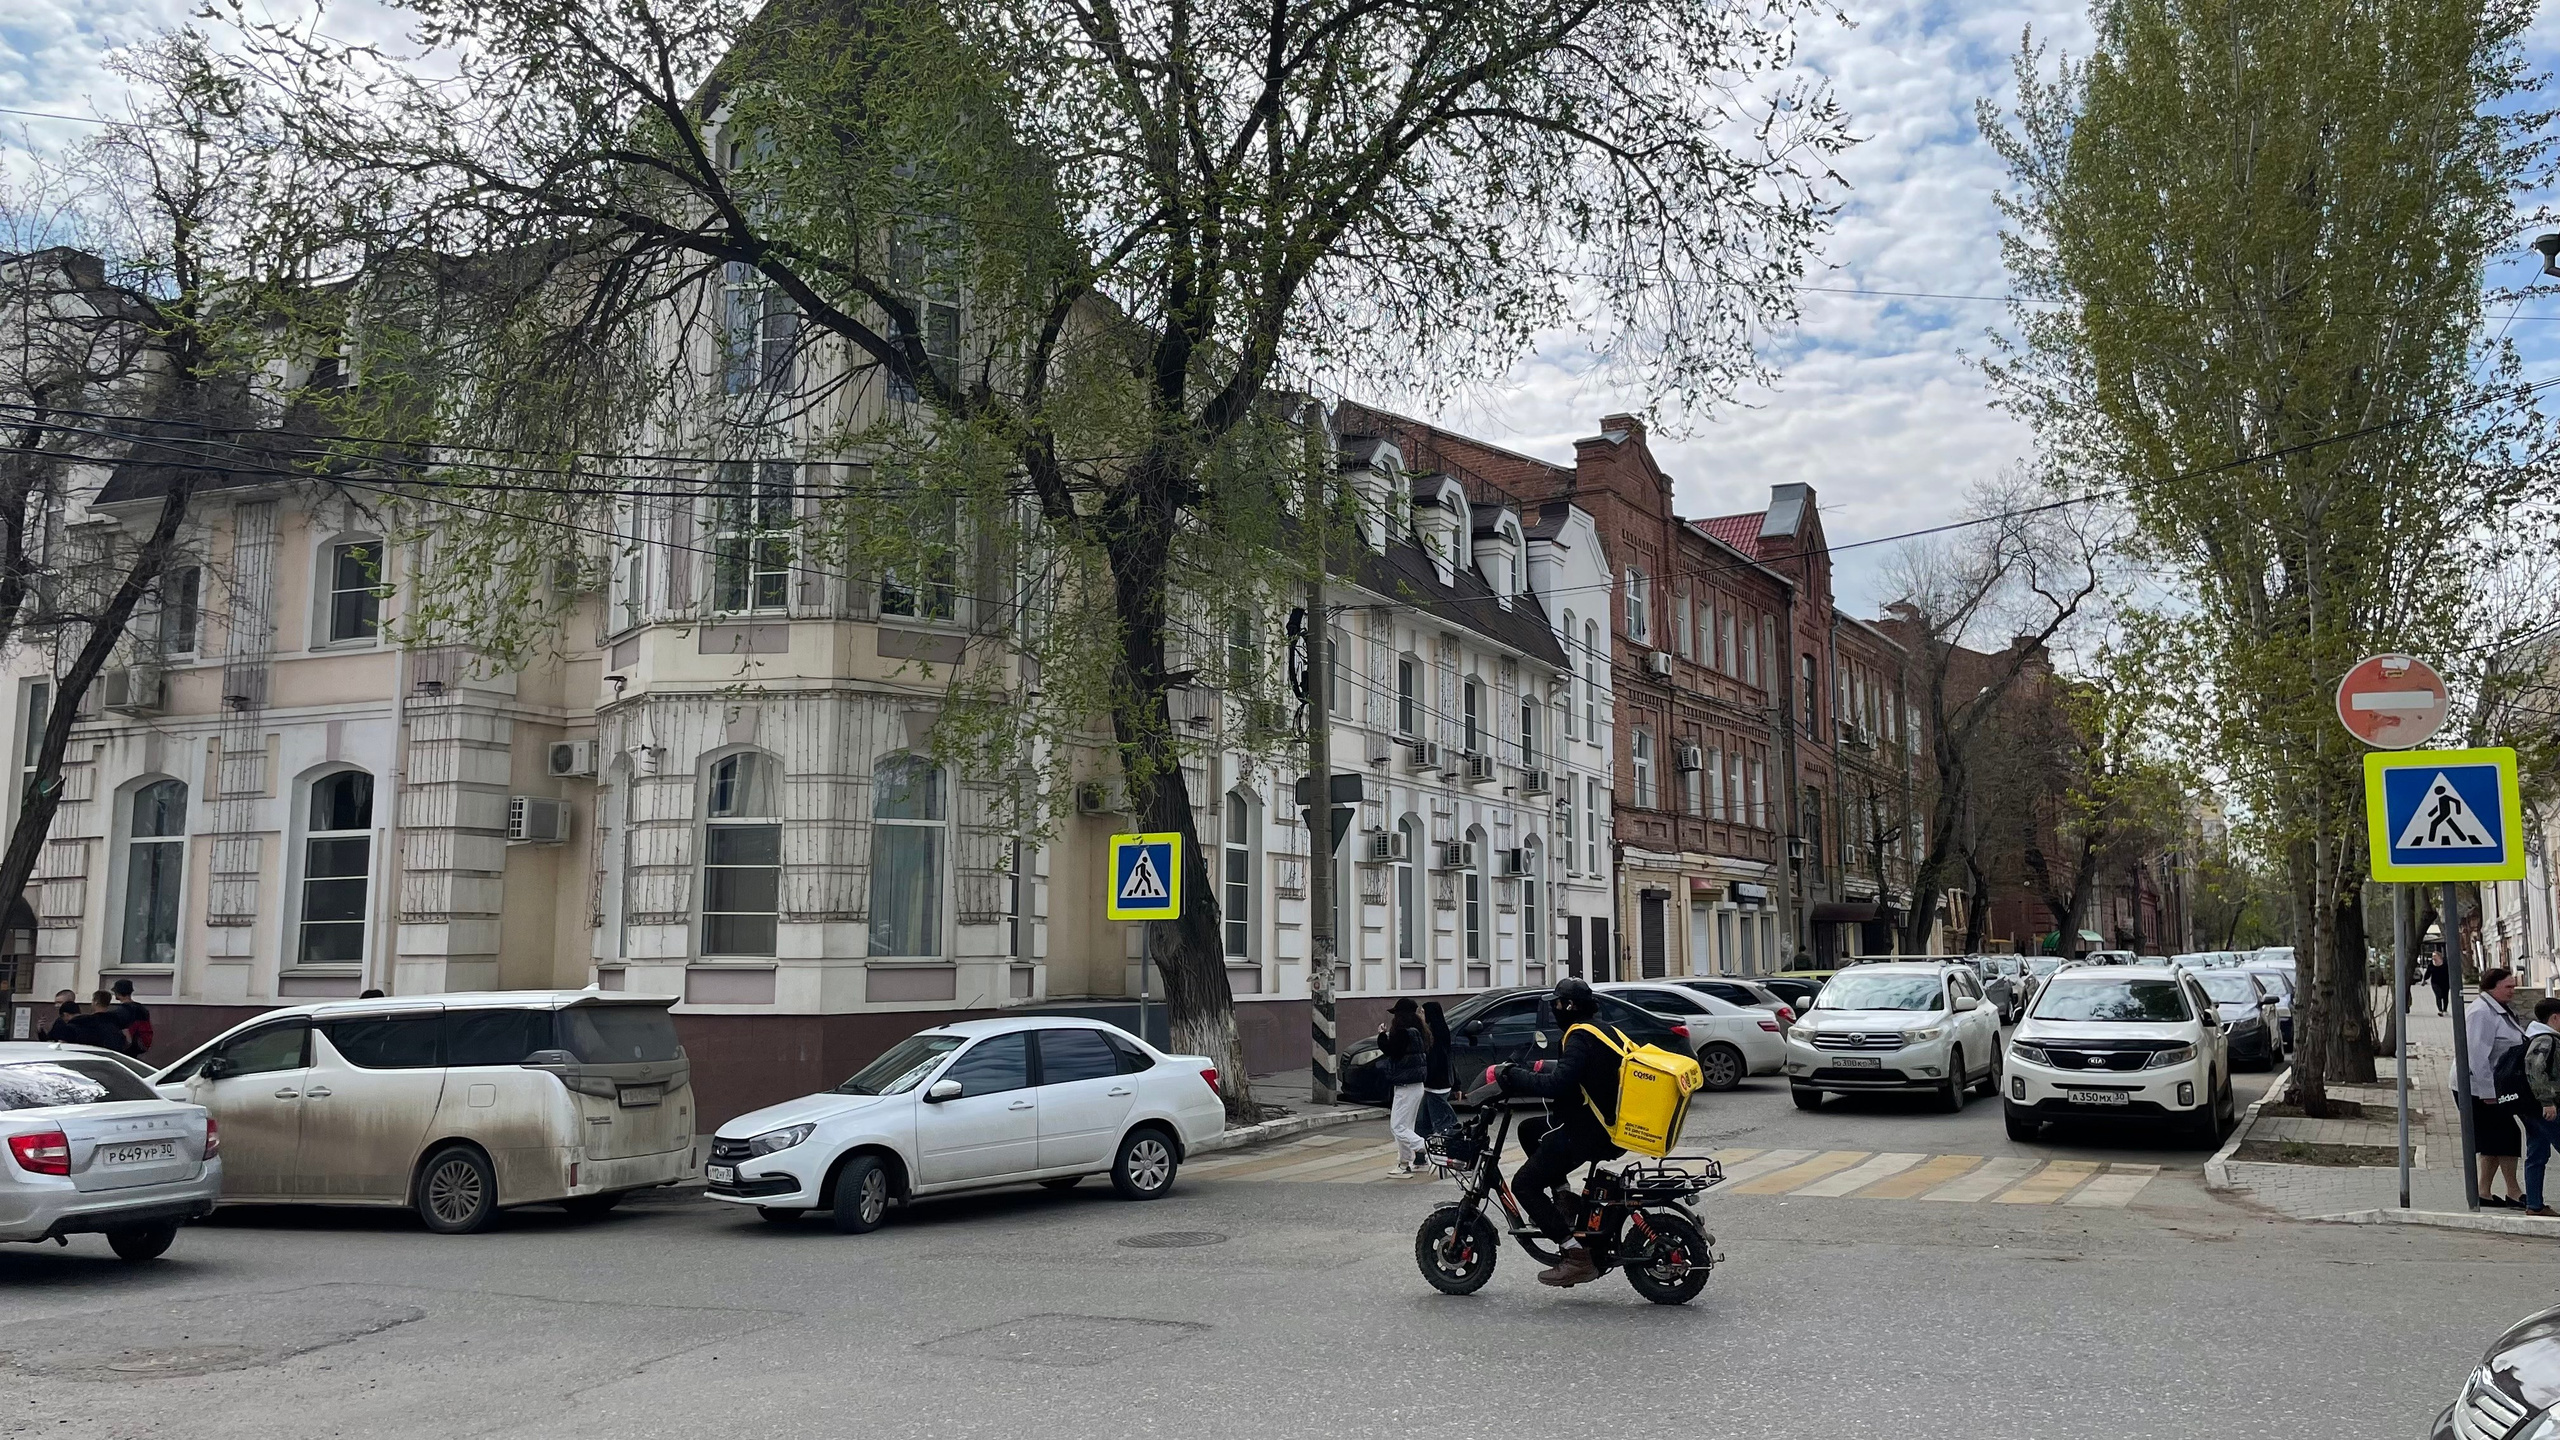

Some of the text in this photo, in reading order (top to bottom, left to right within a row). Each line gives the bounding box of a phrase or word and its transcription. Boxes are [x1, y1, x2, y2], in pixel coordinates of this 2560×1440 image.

[2072, 1092, 2125, 1103] А350МХ 30
[116, 1120, 169, 1131] LADA
[109, 1144, 172, 1162] Р649УР 30
